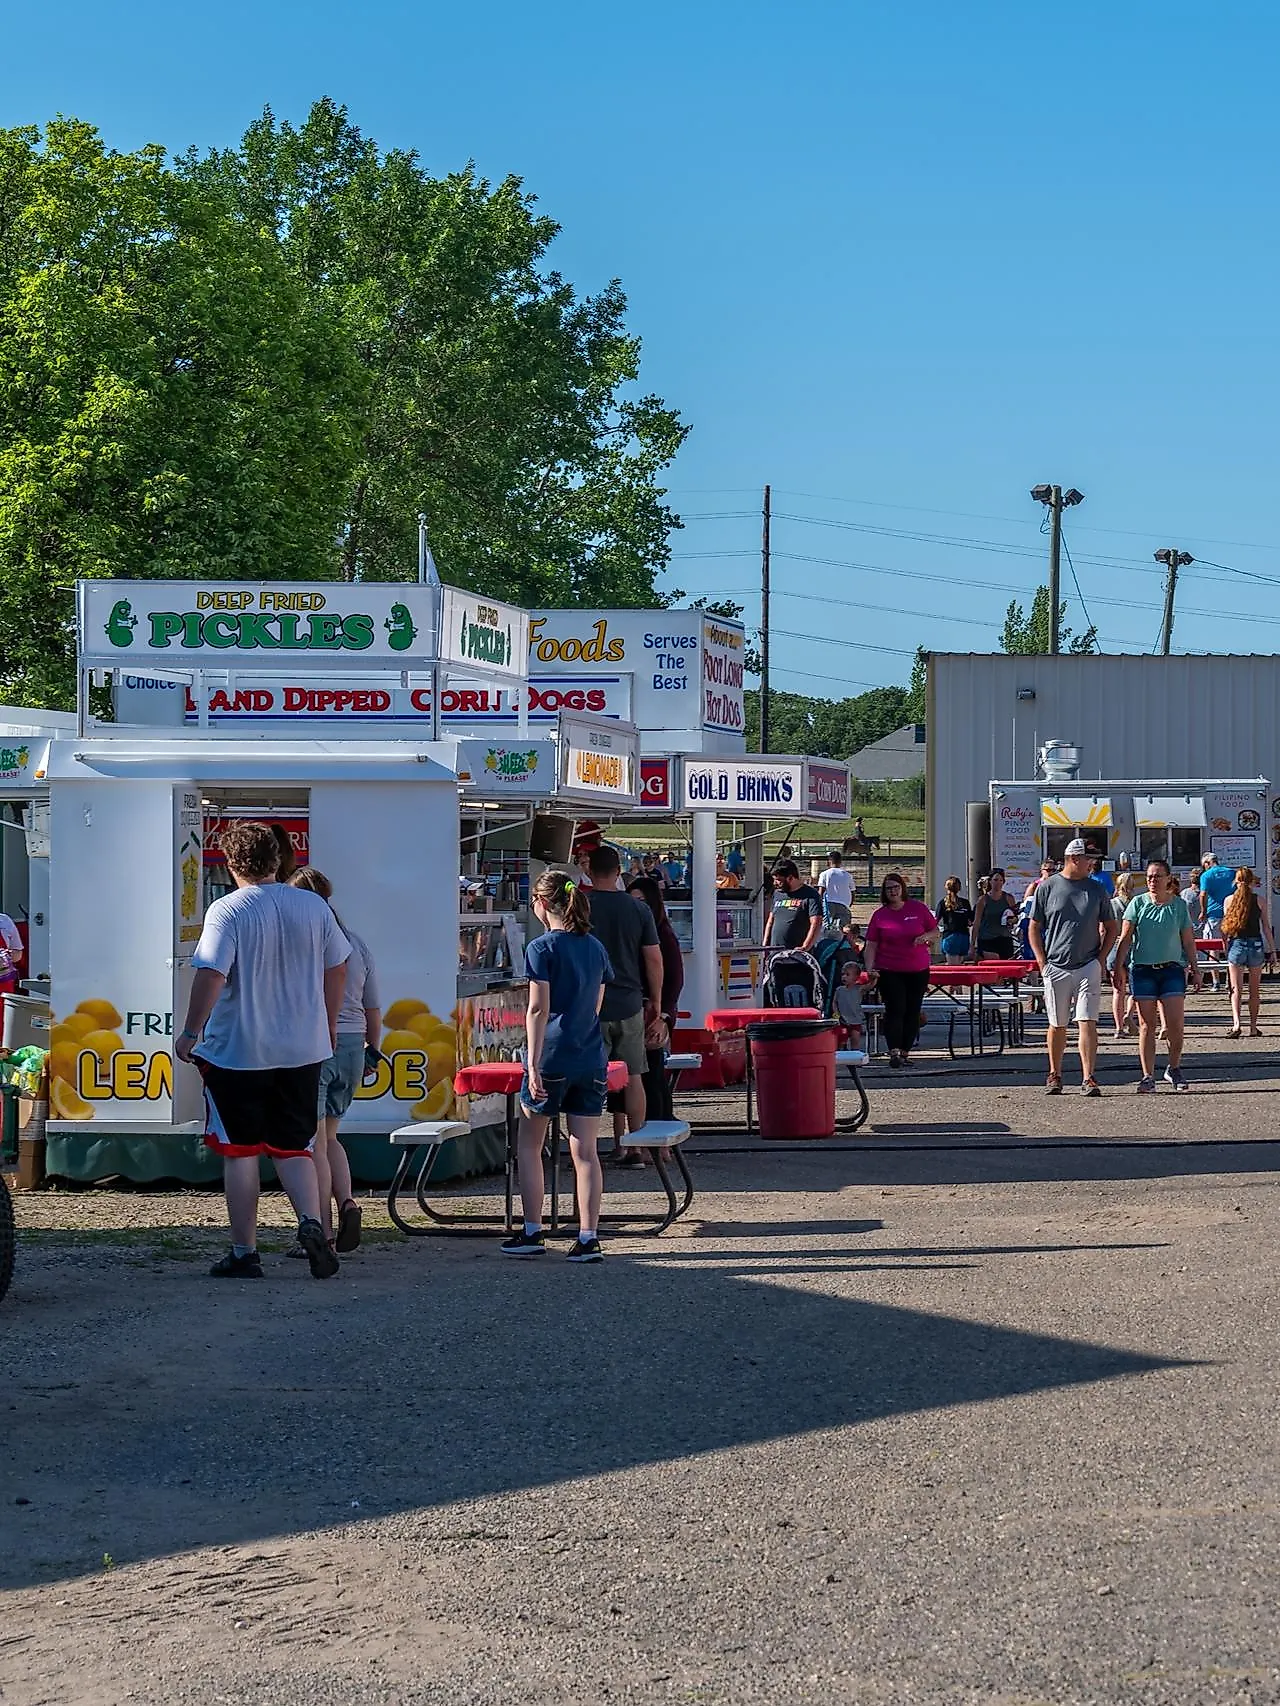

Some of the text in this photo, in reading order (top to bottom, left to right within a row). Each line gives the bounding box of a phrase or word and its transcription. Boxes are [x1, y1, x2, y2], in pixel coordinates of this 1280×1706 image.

[197, 591, 326, 611] DEEP FRIED
[148, 613, 375, 650] PICKLES
[528, 616, 625, 663] Foods
[643, 633, 697, 649] Serves
[656, 653, 685, 669] The
[126, 675, 176, 690] Choice
[653, 674, 688, 690] Best
[282, 687, 391, 712] DIPPED
[410, 688, 501, 712] CORN
[706, 690, 722, 723] HOT
[688, 769, 729, 801] COLD
[736, 769, 793, 802] DRINKS
[1000, 806, 1035, 821] Ruby's
[126, 1011, 173, 1036] FRE
